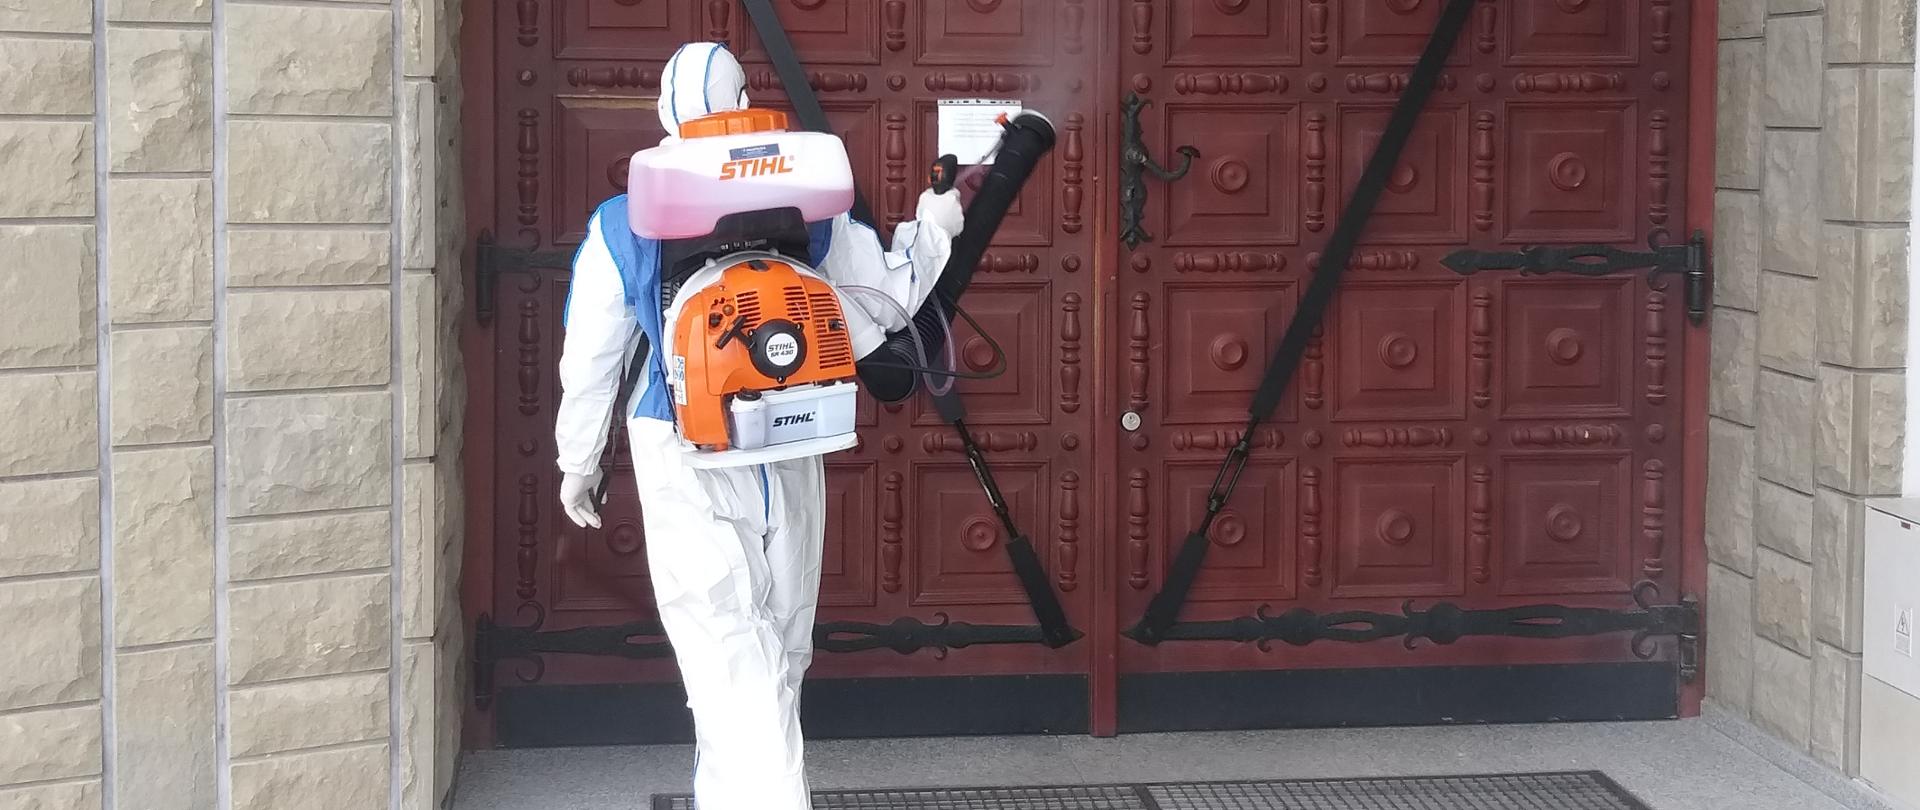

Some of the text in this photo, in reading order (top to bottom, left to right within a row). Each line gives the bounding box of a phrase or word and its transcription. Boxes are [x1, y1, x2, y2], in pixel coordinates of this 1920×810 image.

[719, 156, 793, 180] STIHL
[768, 343, 794, 352] STIHL
[773, 412, 814, 427] STIHL
